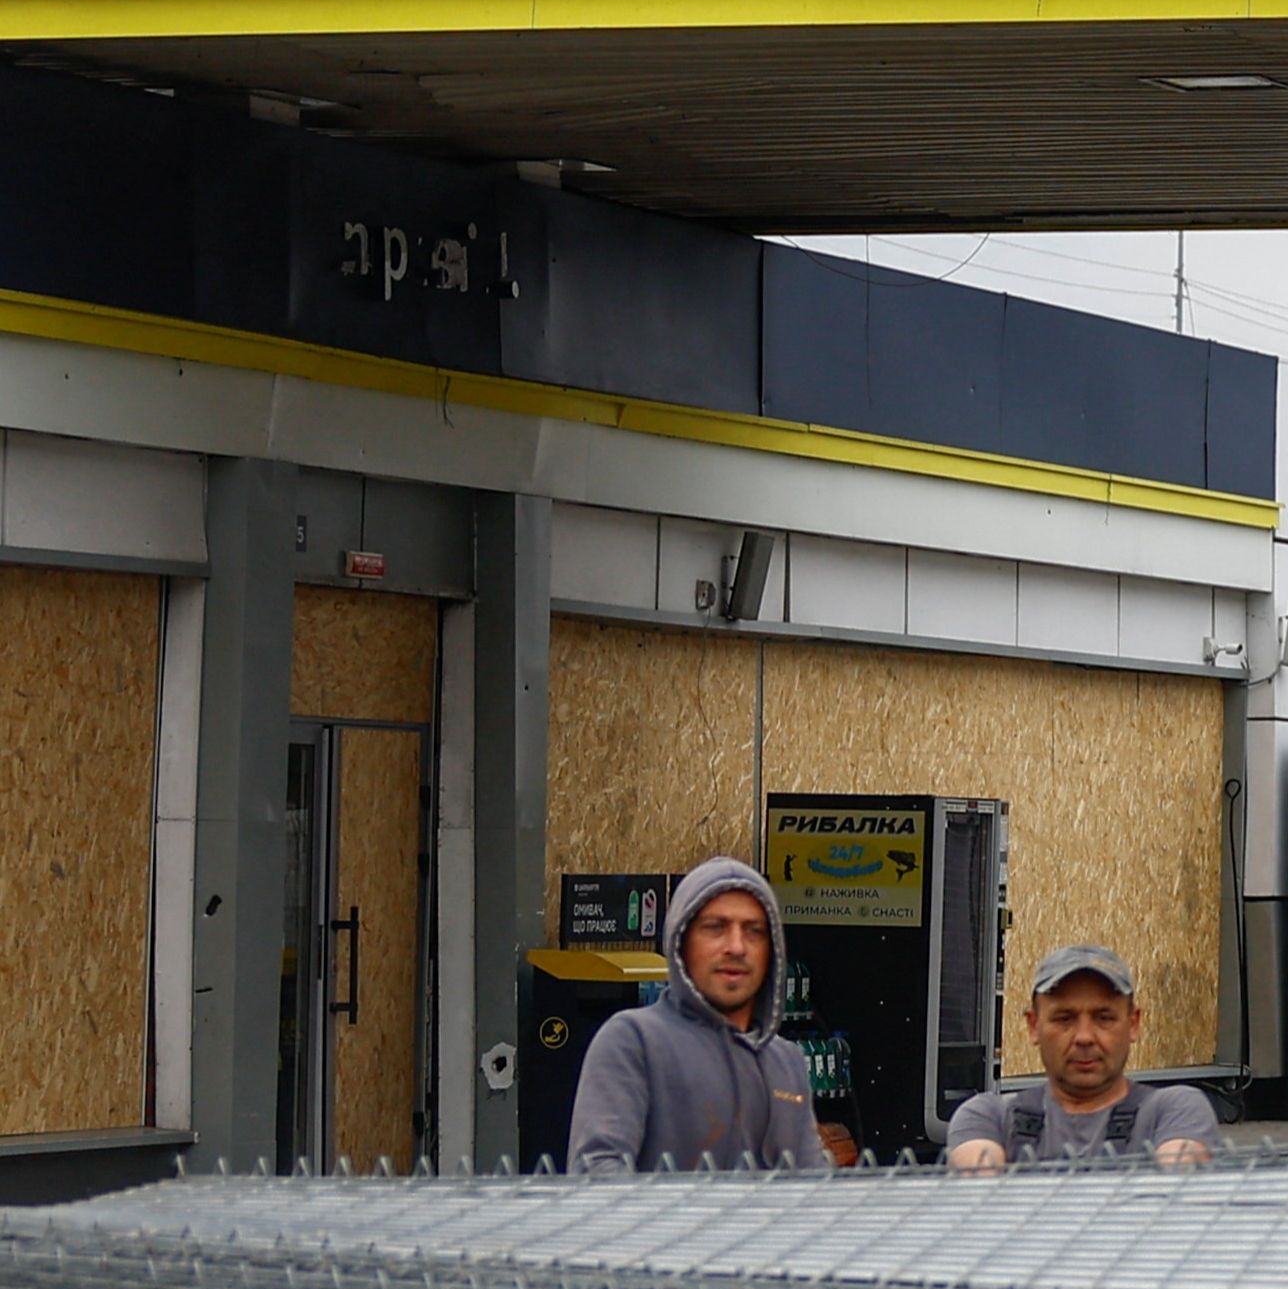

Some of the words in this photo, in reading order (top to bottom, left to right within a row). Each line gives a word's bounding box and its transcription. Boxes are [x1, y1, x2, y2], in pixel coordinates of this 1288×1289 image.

[778, 816, 916, 834] РИБАЛКА
[820, 888, 880, 899] НАЖИВКА
[784, 905, 852, 916] ПРИМАНКА
[872, 907, 914, 918] СНАСТІ
